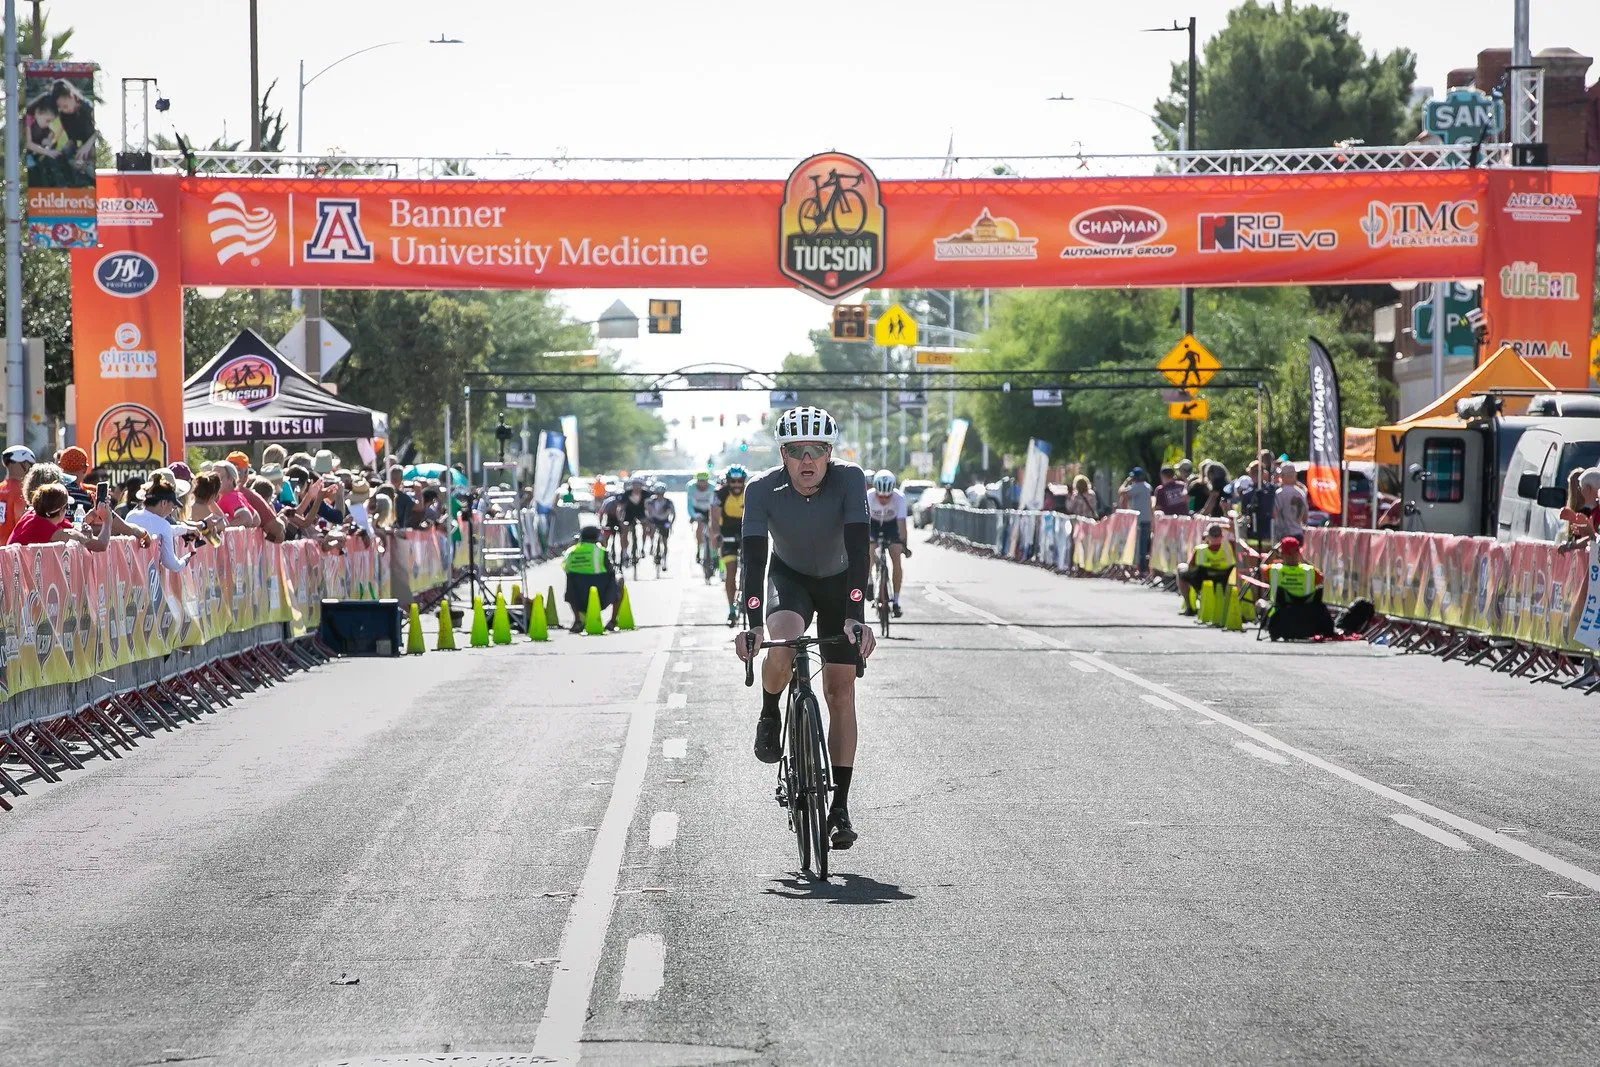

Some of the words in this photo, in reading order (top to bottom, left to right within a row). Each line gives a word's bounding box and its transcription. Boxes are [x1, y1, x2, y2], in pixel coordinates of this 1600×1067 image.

[1436, 104, 1493, 129] SAN
[96, 200, 156, 211] RIZONA
[1509, 195, 1576, 208] ARIZONA
[388, 199, 506, 228] Banner
[1237, 214, 1281, 229] RIO
[1392, 201, 1478, 233] TMC
[1079, 219, 1158, 235] CHAPMAN
[1237, 232, 1336, 249] NUEVO
[1392, 235, 1476, 246] HEALTHCARE
[389, 236, 552, 275] University
[558, 236, 709, 267] Medicine
[793, 246, 872, 271] TUCSON
[1062, 246, 1134, 257] AUTOMOTIVE
[1137, 246, 1175, 255] GROUP
[185, 419, 226, 437] TOUR
[233, 419, 253, 436] DE
[261, 417, 324, 435] TUCSON
